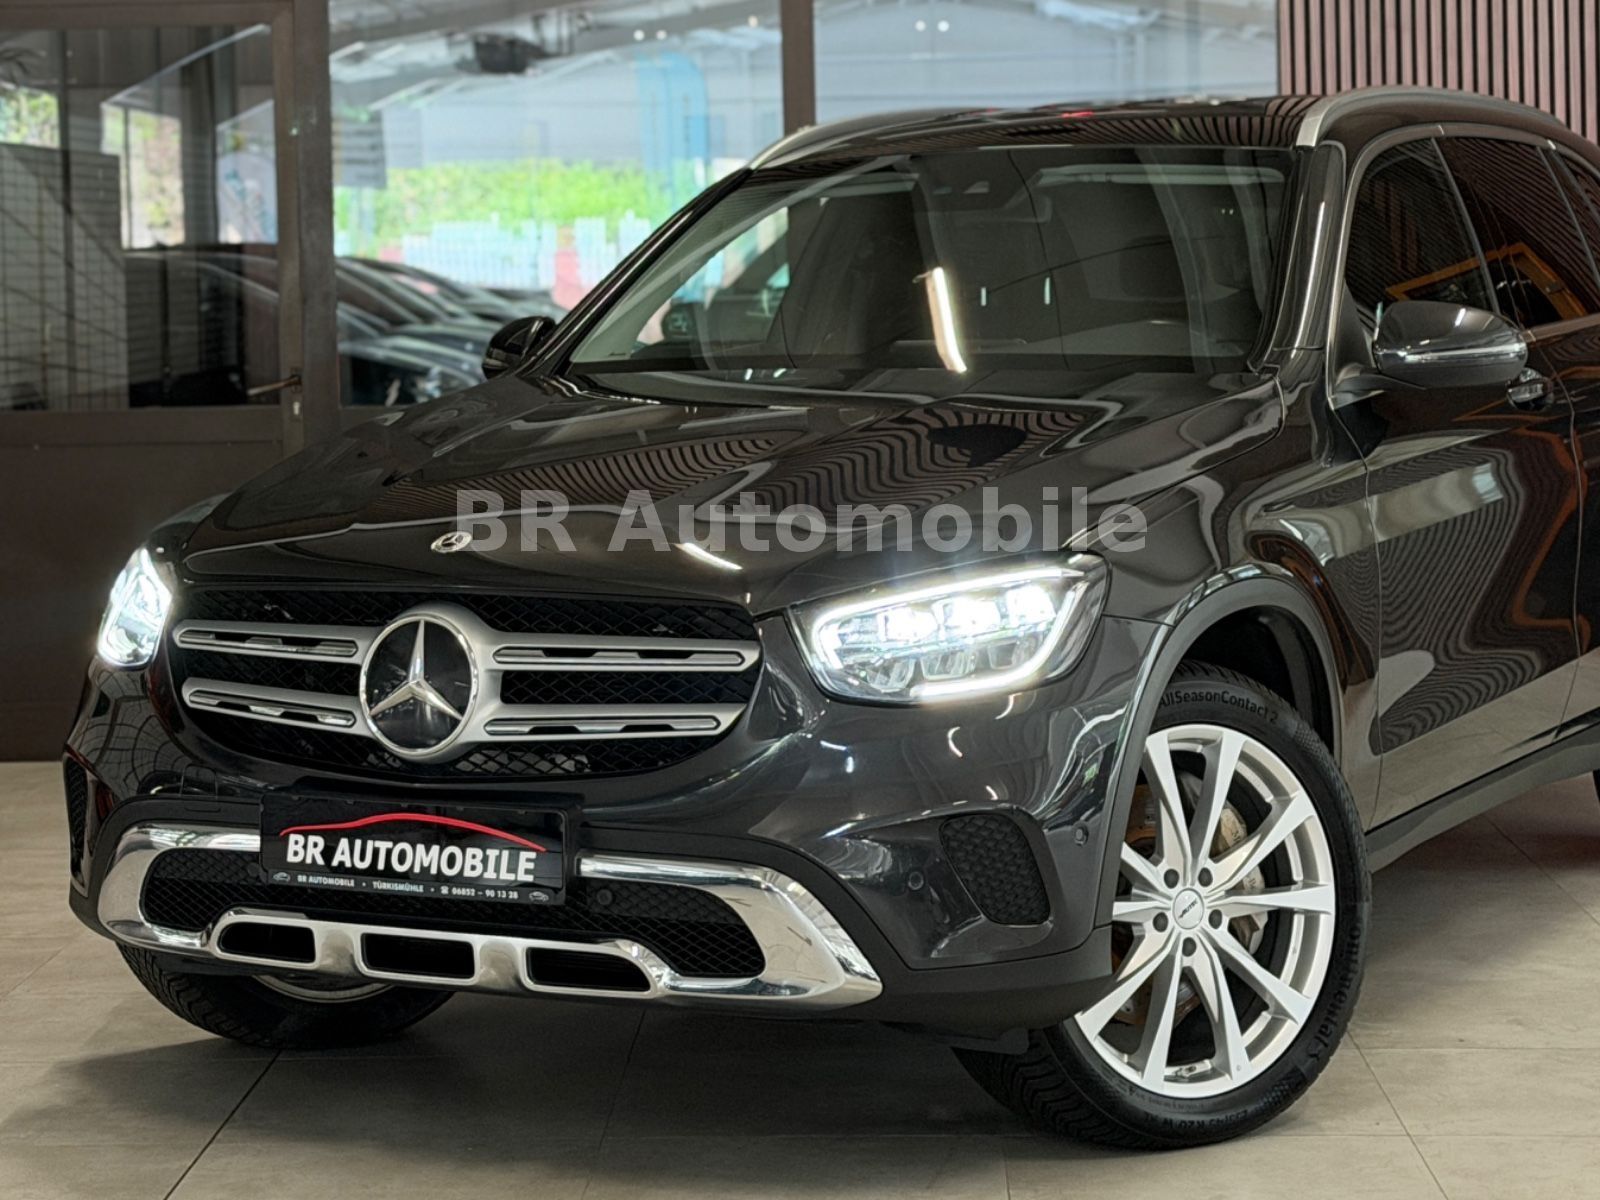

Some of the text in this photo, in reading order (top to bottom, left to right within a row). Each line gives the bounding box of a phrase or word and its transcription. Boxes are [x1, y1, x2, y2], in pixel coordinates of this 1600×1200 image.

[1158, 689, 1270, 718] AllSeasonContact
[286, 833, 537, 881] BR AUTOMOBILE
[297, 874, 309, 884] BR
[309, 875, 355, 887] AUTOMOBILE
[372, 880, 424, 893] TÜRKISMÜHLE
[452, 887, 476, 898] 06852
[485, 889, 496, 899] 90
[497, 890, 507, 899] 13
[508, 890, 519, 900] 28
